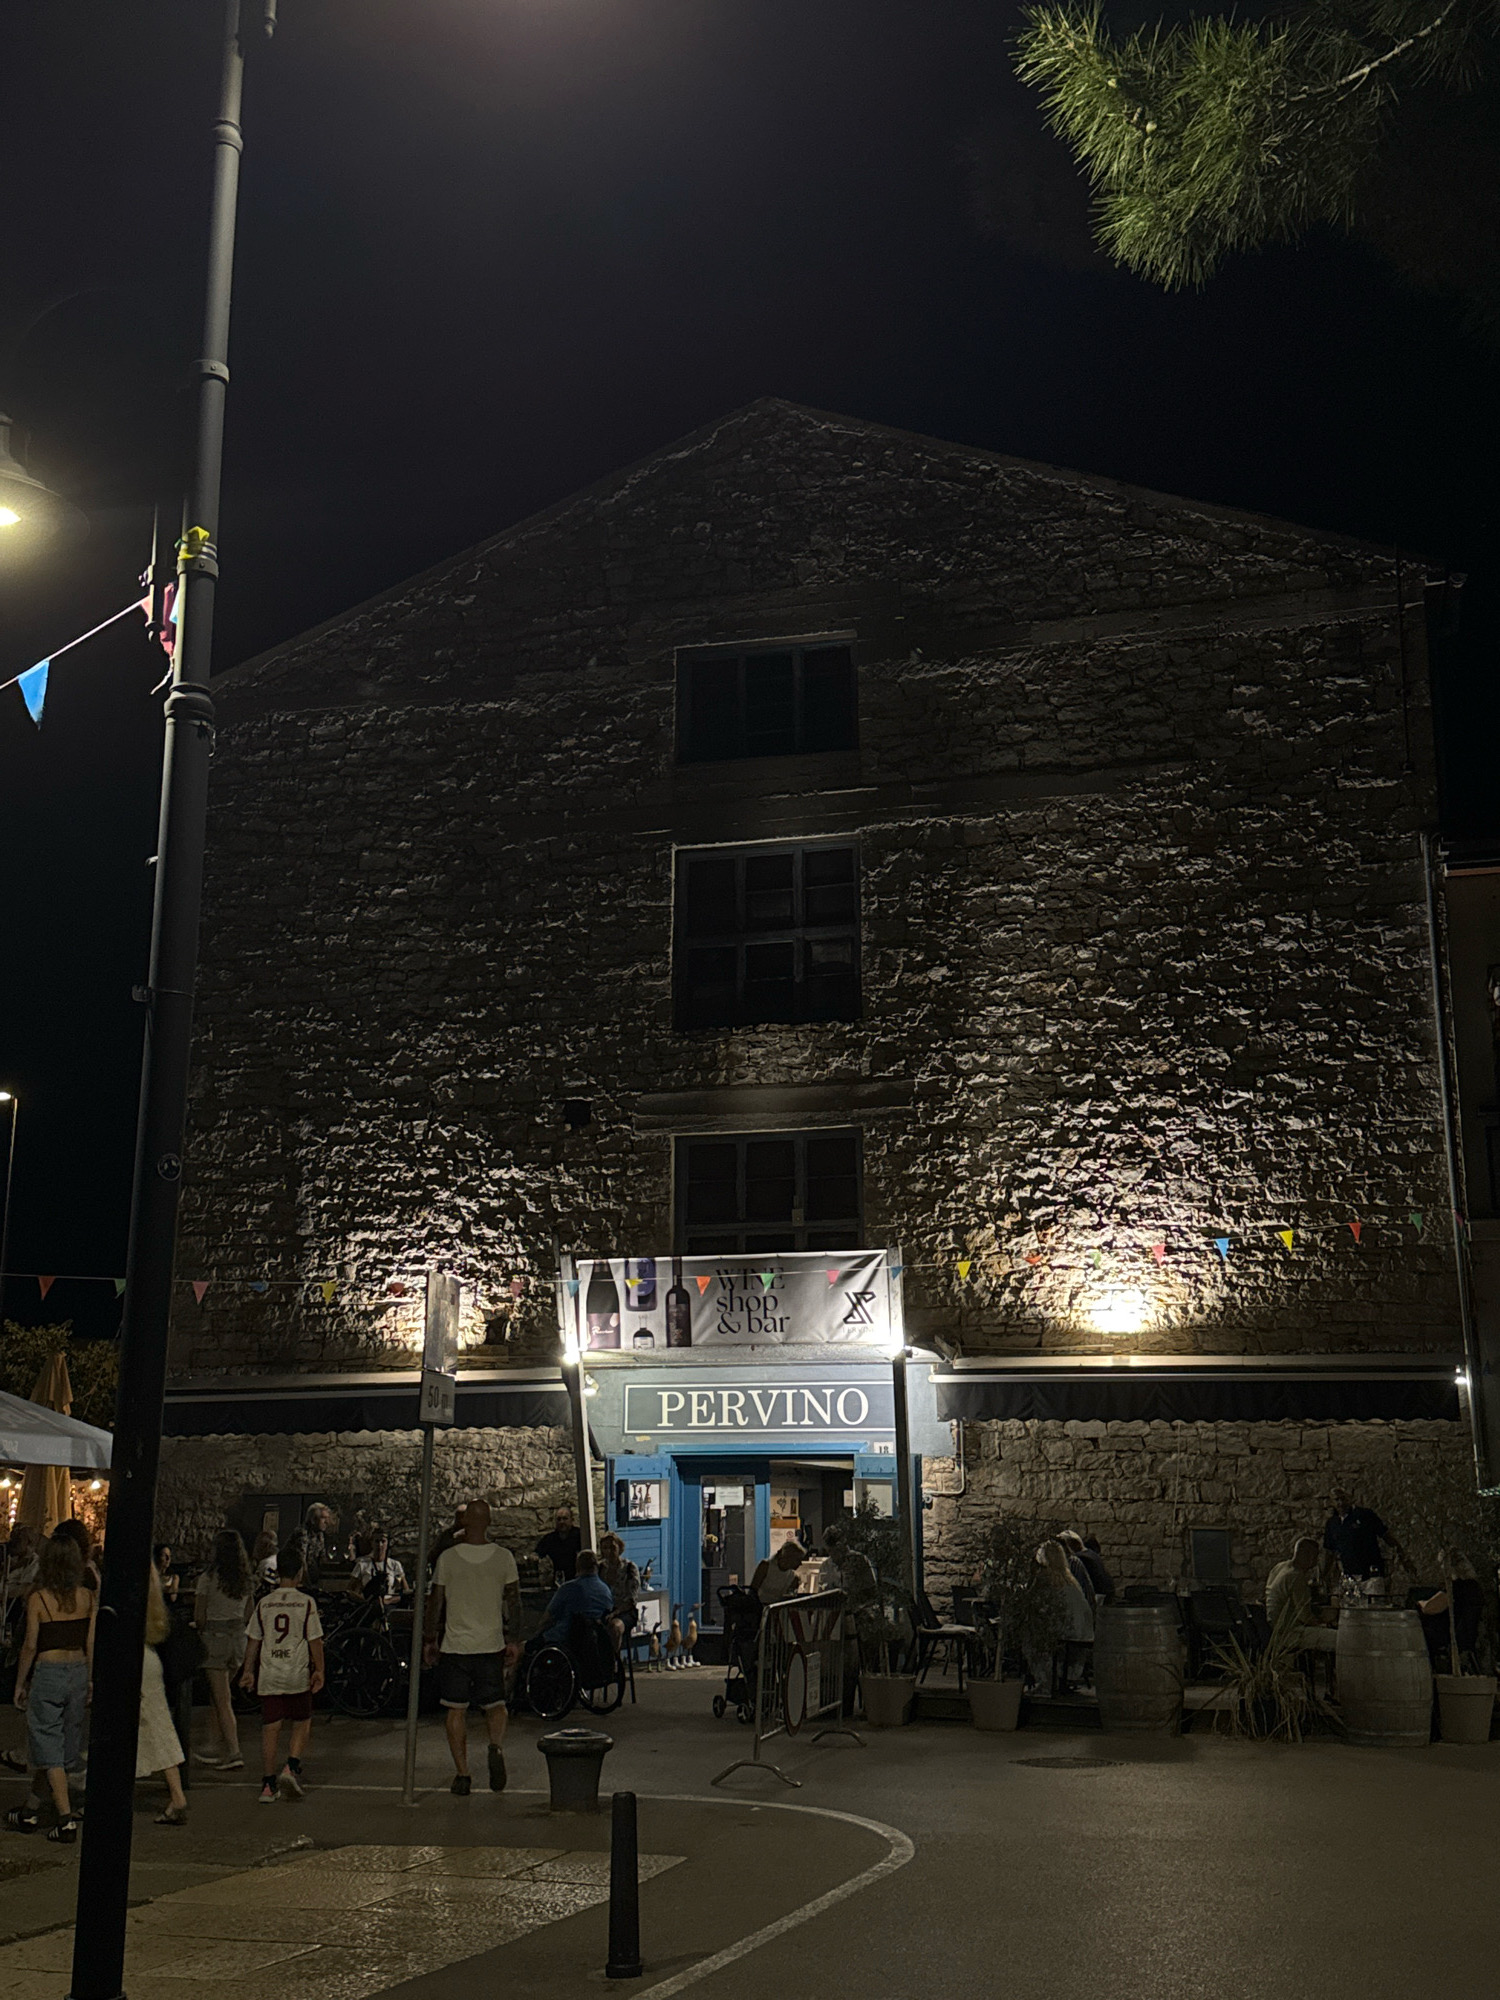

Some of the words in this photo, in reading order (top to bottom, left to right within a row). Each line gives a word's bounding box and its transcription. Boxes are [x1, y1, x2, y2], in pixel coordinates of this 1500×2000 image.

[716, 1287, 778, 1319] shop
[717, 1312, 741, 1334] &
[747, 1309, 791, 1334] bar
[428, 1385, 440, 1408] 50
[657, 1388, 869, 1426] PERVINO
[879, 1445, 889, 1454] 18
[275, 1613, 289, 1644] 9
